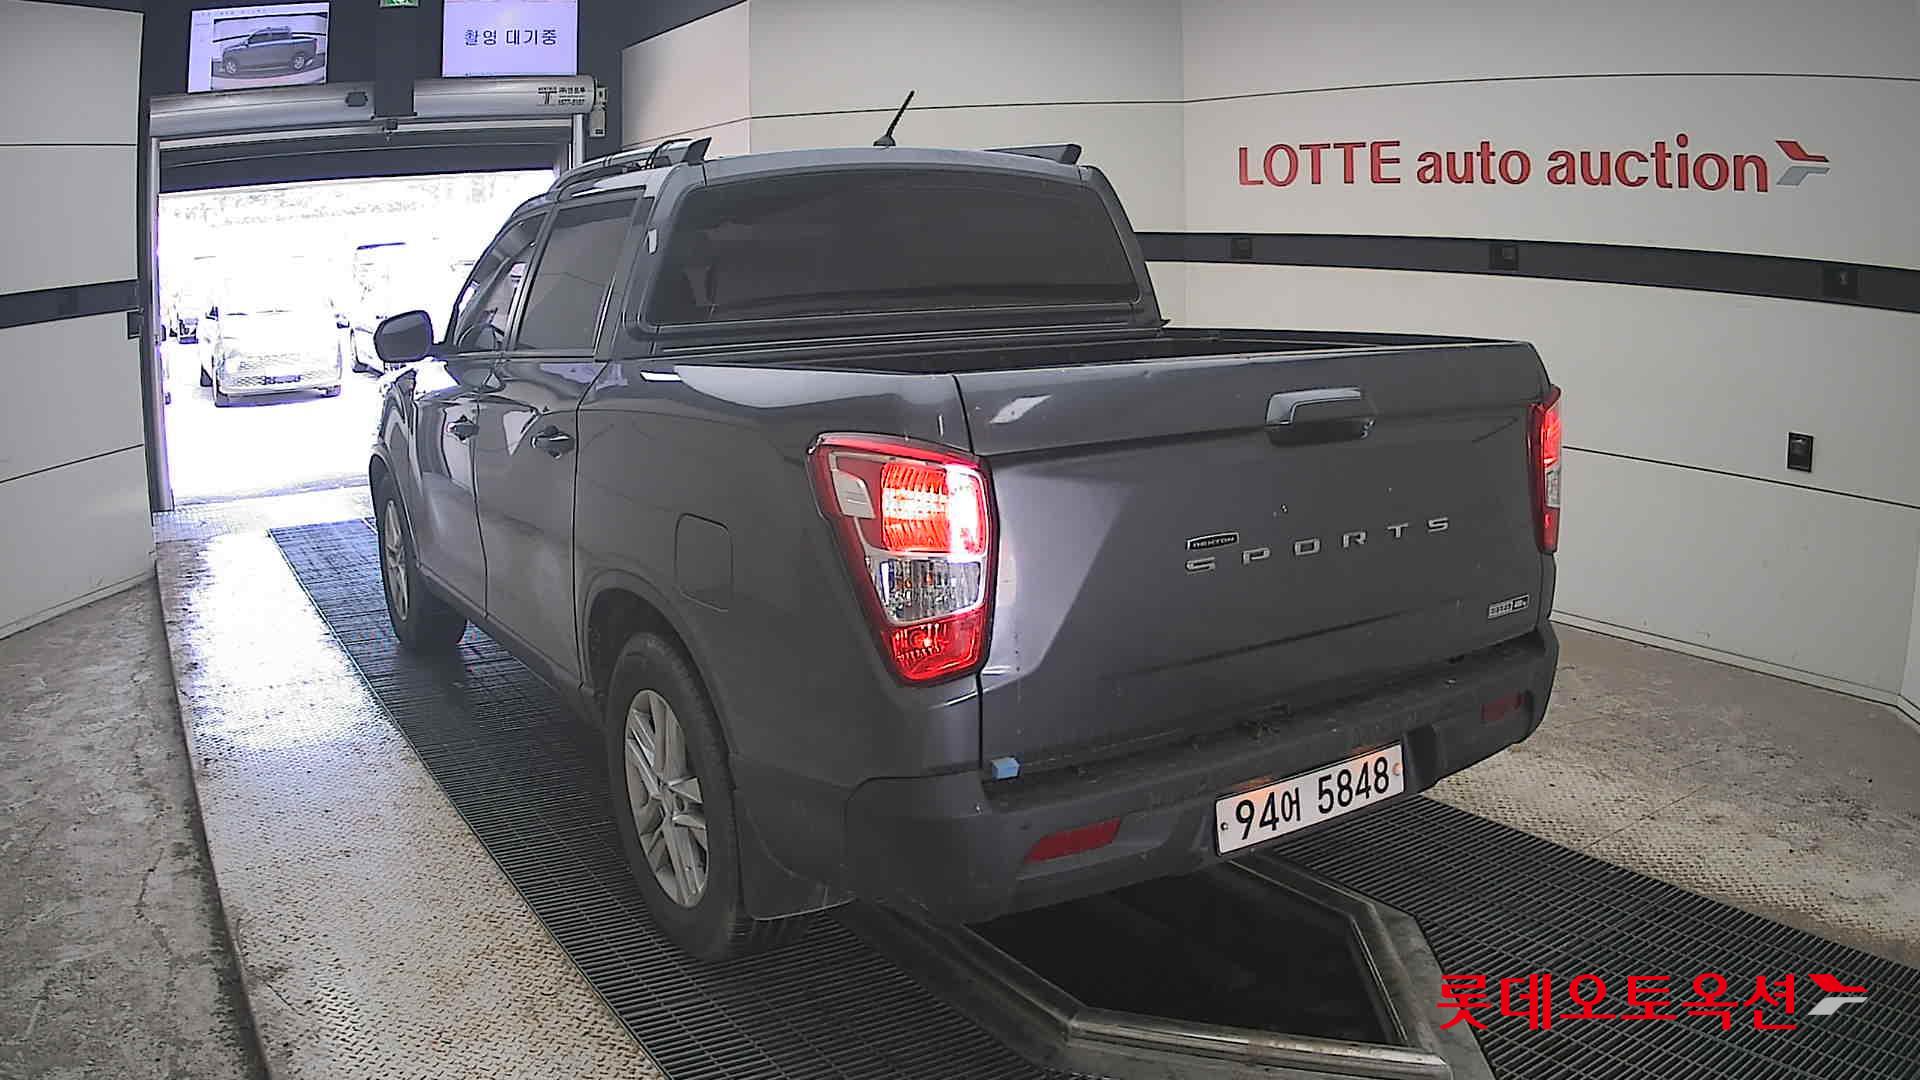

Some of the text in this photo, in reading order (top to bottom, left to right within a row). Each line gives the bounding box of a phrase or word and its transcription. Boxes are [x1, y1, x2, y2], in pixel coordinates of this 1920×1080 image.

[506, 29, 558, 46] 대기중
[1238, 134, 1769, 193] LOTTE auto auction
[1185, 516, 1449, 575] SPORTS
[1235, 756, 1389, 841] 94어 5848
